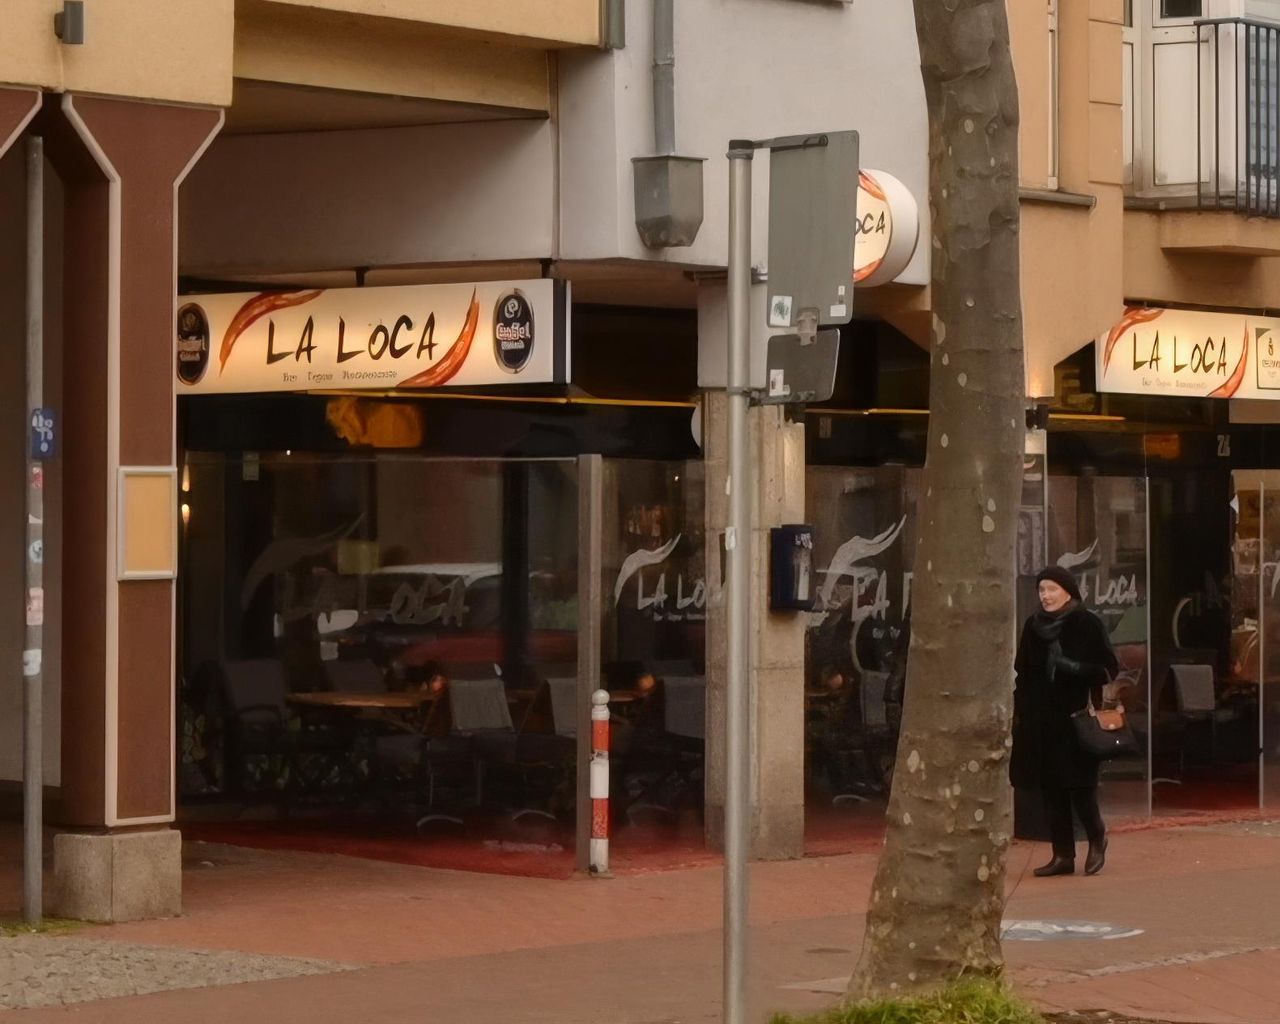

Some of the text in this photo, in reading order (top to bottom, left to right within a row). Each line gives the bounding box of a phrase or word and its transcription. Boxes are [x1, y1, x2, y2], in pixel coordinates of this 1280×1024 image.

[855, 211, 886, 235] OCA
[266, 315, 318, 365] LA
[336, 311, 439, 364] LOCA
[1132, 330, 1227, 377] LA LOCA
[637, 572, 669, 610] LA
